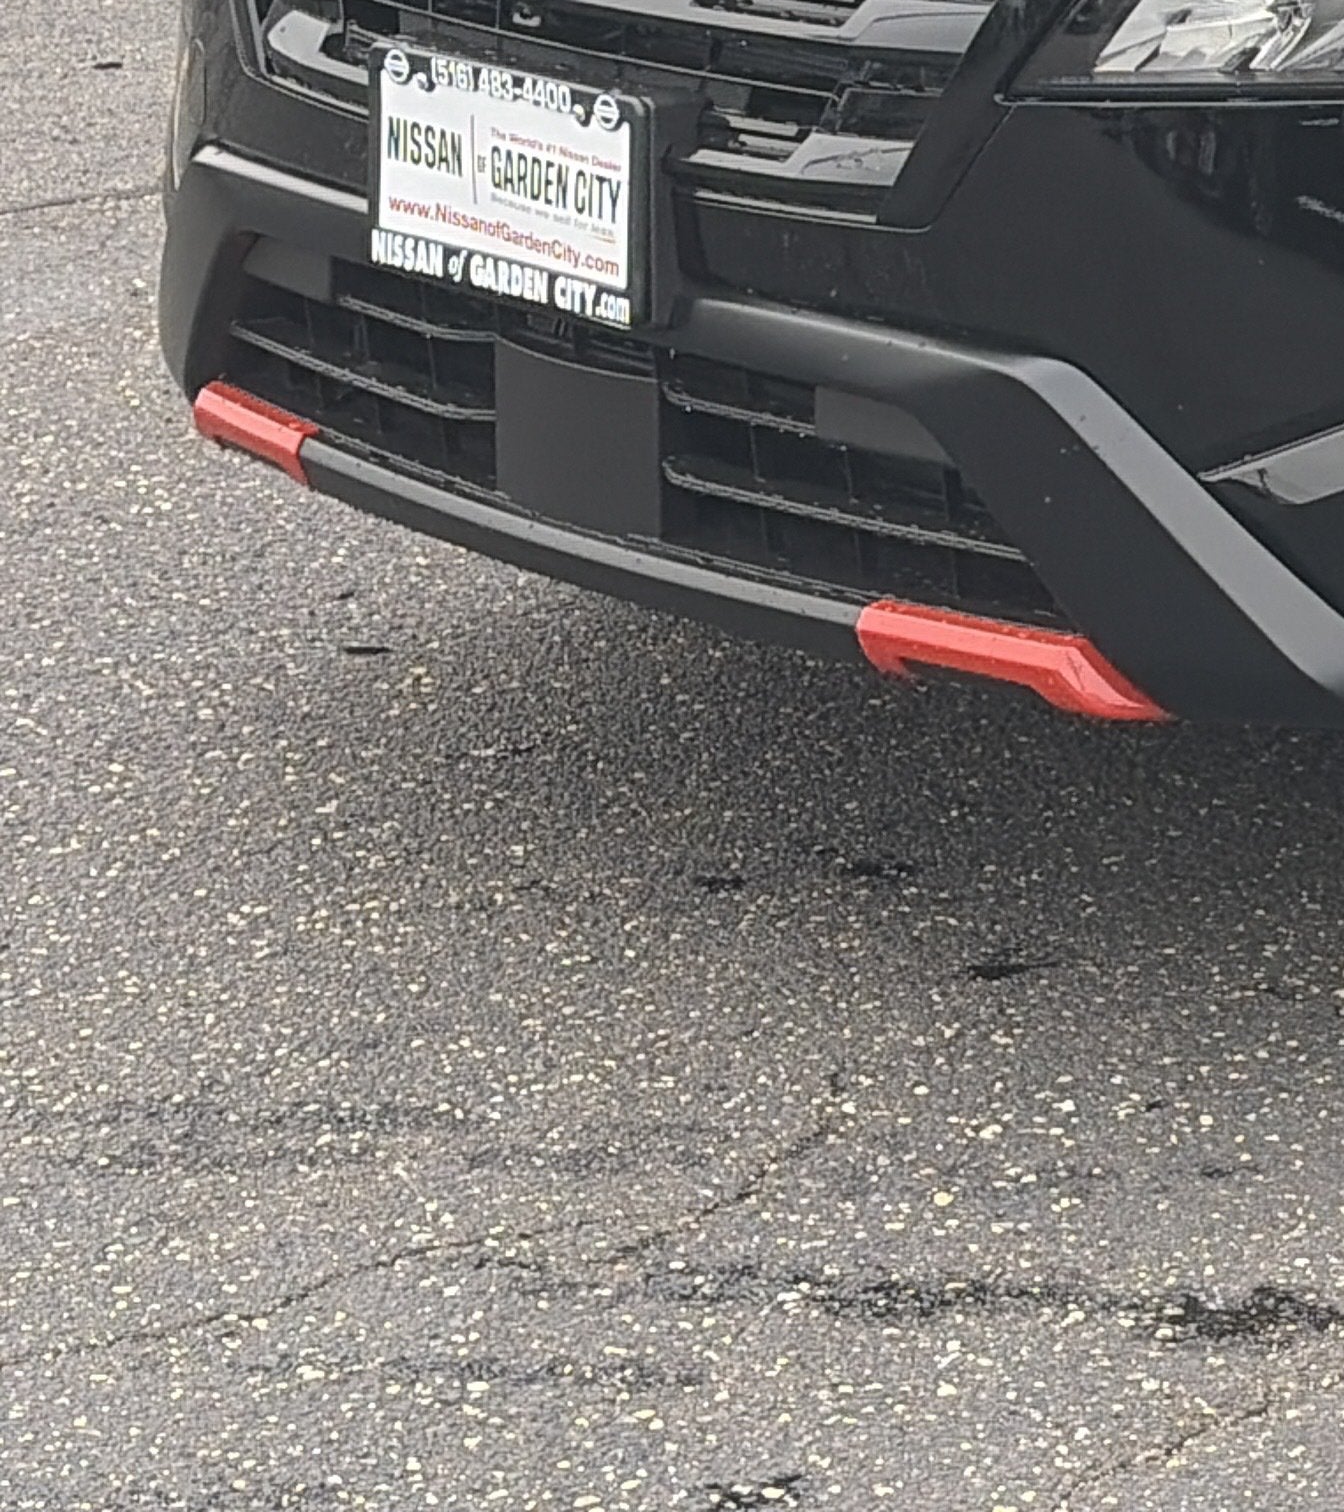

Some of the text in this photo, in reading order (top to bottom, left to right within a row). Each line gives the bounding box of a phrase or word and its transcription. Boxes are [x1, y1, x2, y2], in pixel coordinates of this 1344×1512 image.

[430, 56, 573, 114] (516) 483-4400
[387, 115, 463, 178] NISSAN
[490, 144, 570, 210] GARDEN
[573, 168, 622, 224] CITY
[370, 228, 445, 279] NISSAN
[447, 249, 468, 283] of
[470, 251, 550, 305] GARDEN
[387, 195, 620, 278] www.NissanofGardenCity.com
